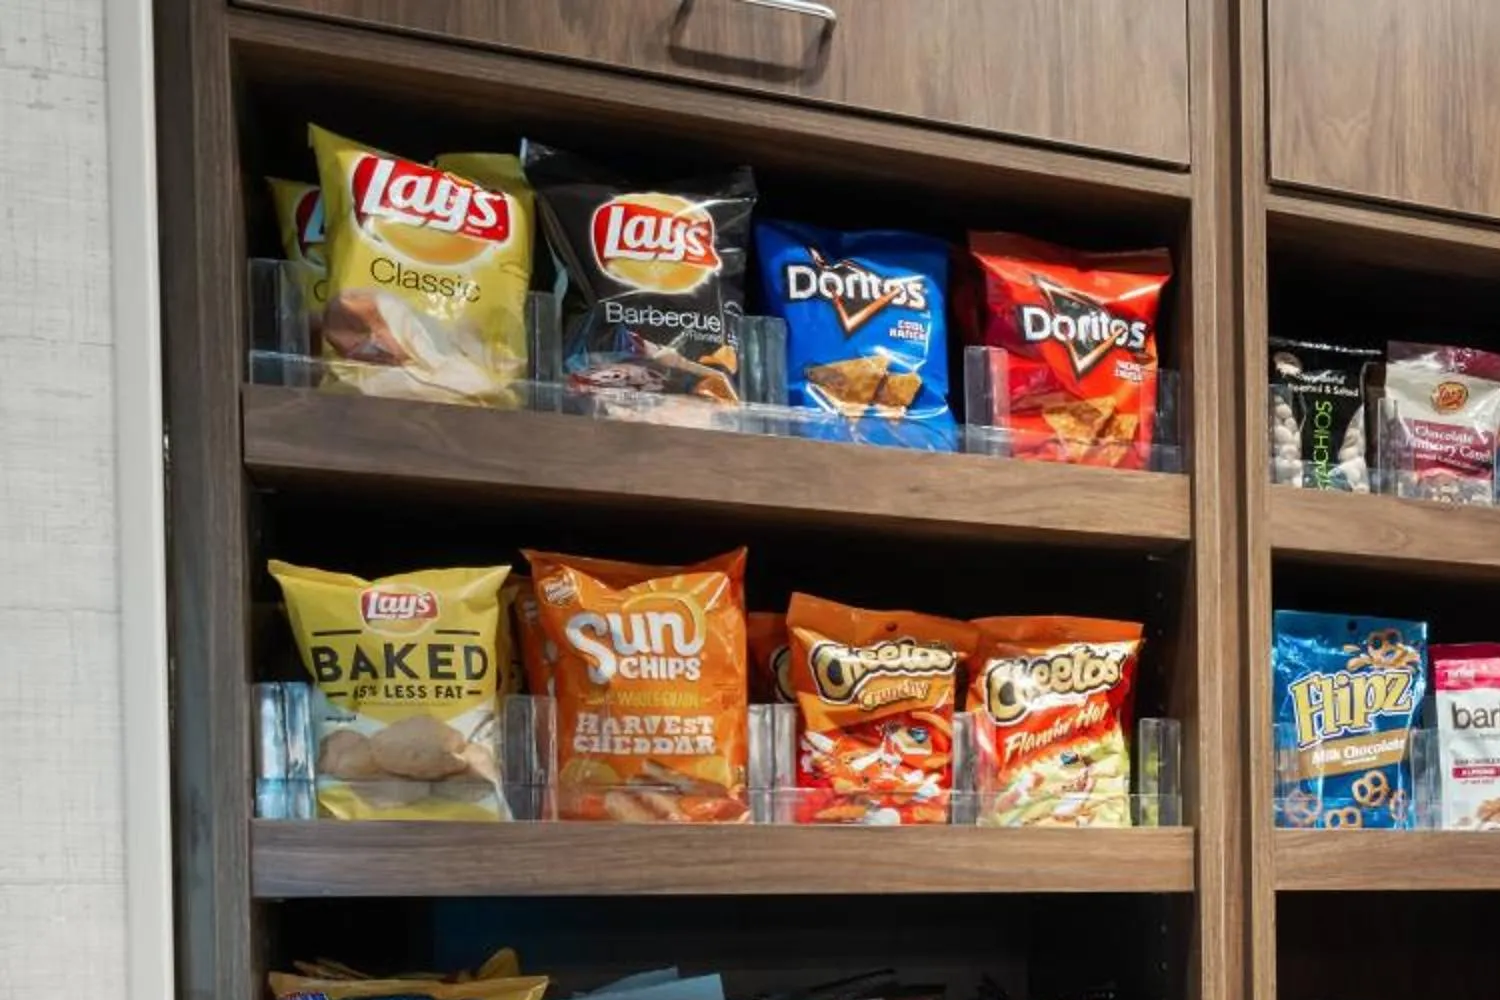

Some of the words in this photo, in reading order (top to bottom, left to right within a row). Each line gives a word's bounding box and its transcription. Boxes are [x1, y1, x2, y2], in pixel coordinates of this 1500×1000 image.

[362, 157, 501, 234] Lay's
[603, 206, 708, 260] Lay's
[370, 256, 481, 303] Classic
[787, 265, 926, 309] Doritos
[606, 302, 721, 332] Barbecue
[1023, 305, 1148, 348] Doritos
[365, 592, 434, 620] Lay's
[311, 643, 489, 684] BAKED
[565, 611, 705, 685] Sun
[619, 656, 701, 681] CHIPS
[384, 685, 428, 699] LESS
[434, 685, 463, 699] FAT
[811, 639, 957, 705] Cheetos
[985, 645, 1124, 726] Cheetos
[575, 711, 714, 735] HARVEST
[1074, 700, 1109, 731] Hot
[1291, 673, 1413, 748] Flipz
[573, 735, 716, 755] CHEDDAR
[1311, 747, 1341, 764] Milk
[1343, 737, 1407, 759] Chocolate
